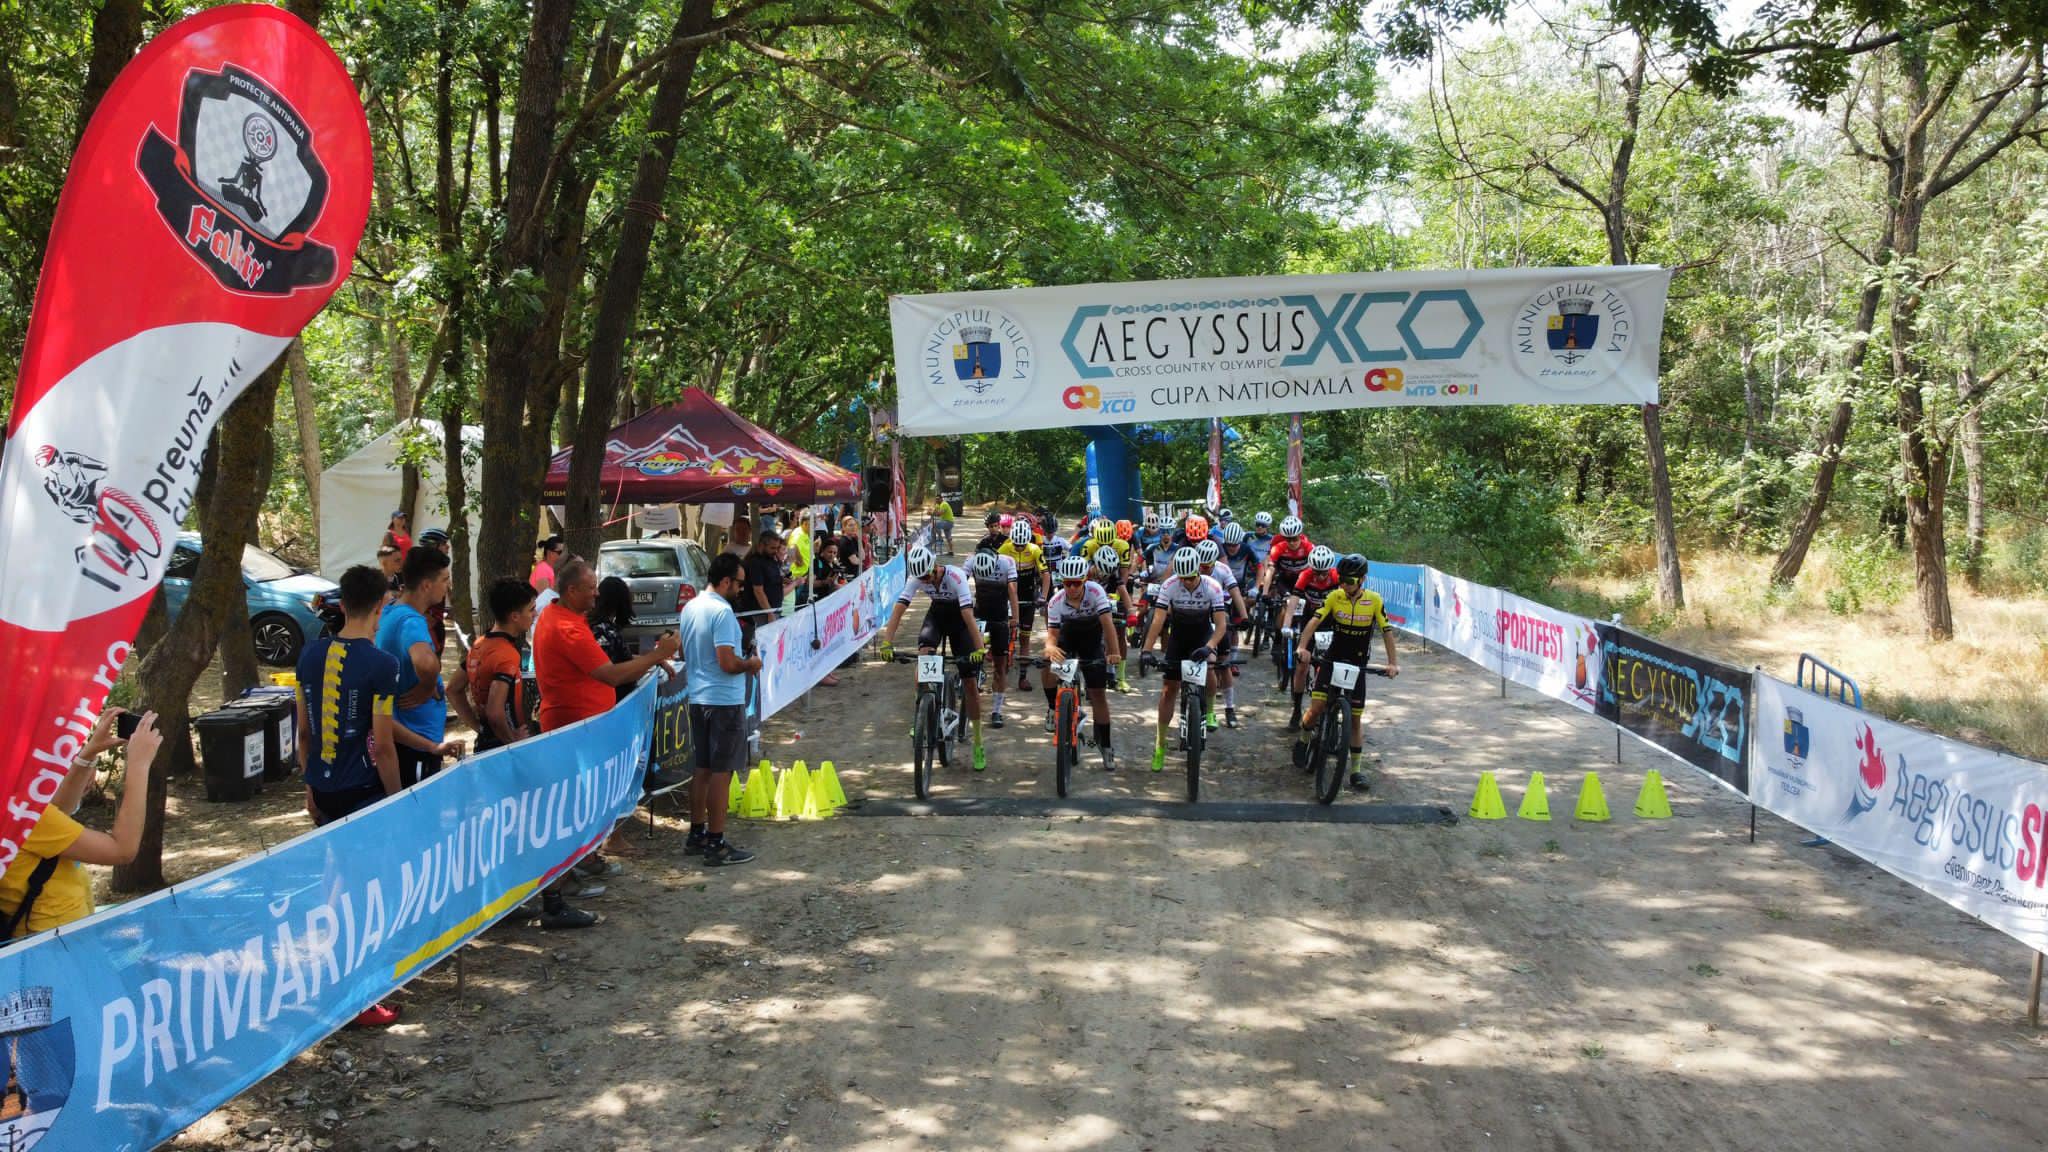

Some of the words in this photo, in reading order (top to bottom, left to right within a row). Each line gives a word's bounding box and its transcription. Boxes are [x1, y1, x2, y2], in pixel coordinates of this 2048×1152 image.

[925, 308, 993, 385] MUNICIPIUL
[999, 315, 1030, 380] TULCEA
[1089, 310, 1305, 363] AEGYSSUS
[1280, 289, 1485, 367] XCO
[1517, 282, 1596, 355] MUNICIPIUL
[1600, 288, 1629, 353] TULCEA
[1115, 366, 1152, 378] CROSS
[1155, 361, 1216, 375] COUNTRY
[1220, 358, 1277, 371] OLYMPIC
[1150, 385, 1209, 407] CUPA
[1218, 376, 1354, 406] NATIONALA
[1100, 399, 1137, 414] XCO
[1495, 607, 1565, 664] SPORTFEST
[922, 662, 938, 675] 34
[96, 877, 386, 1114] PRIMĂRIA
[386, 765, 600, 940] MUNICIPIULUI
